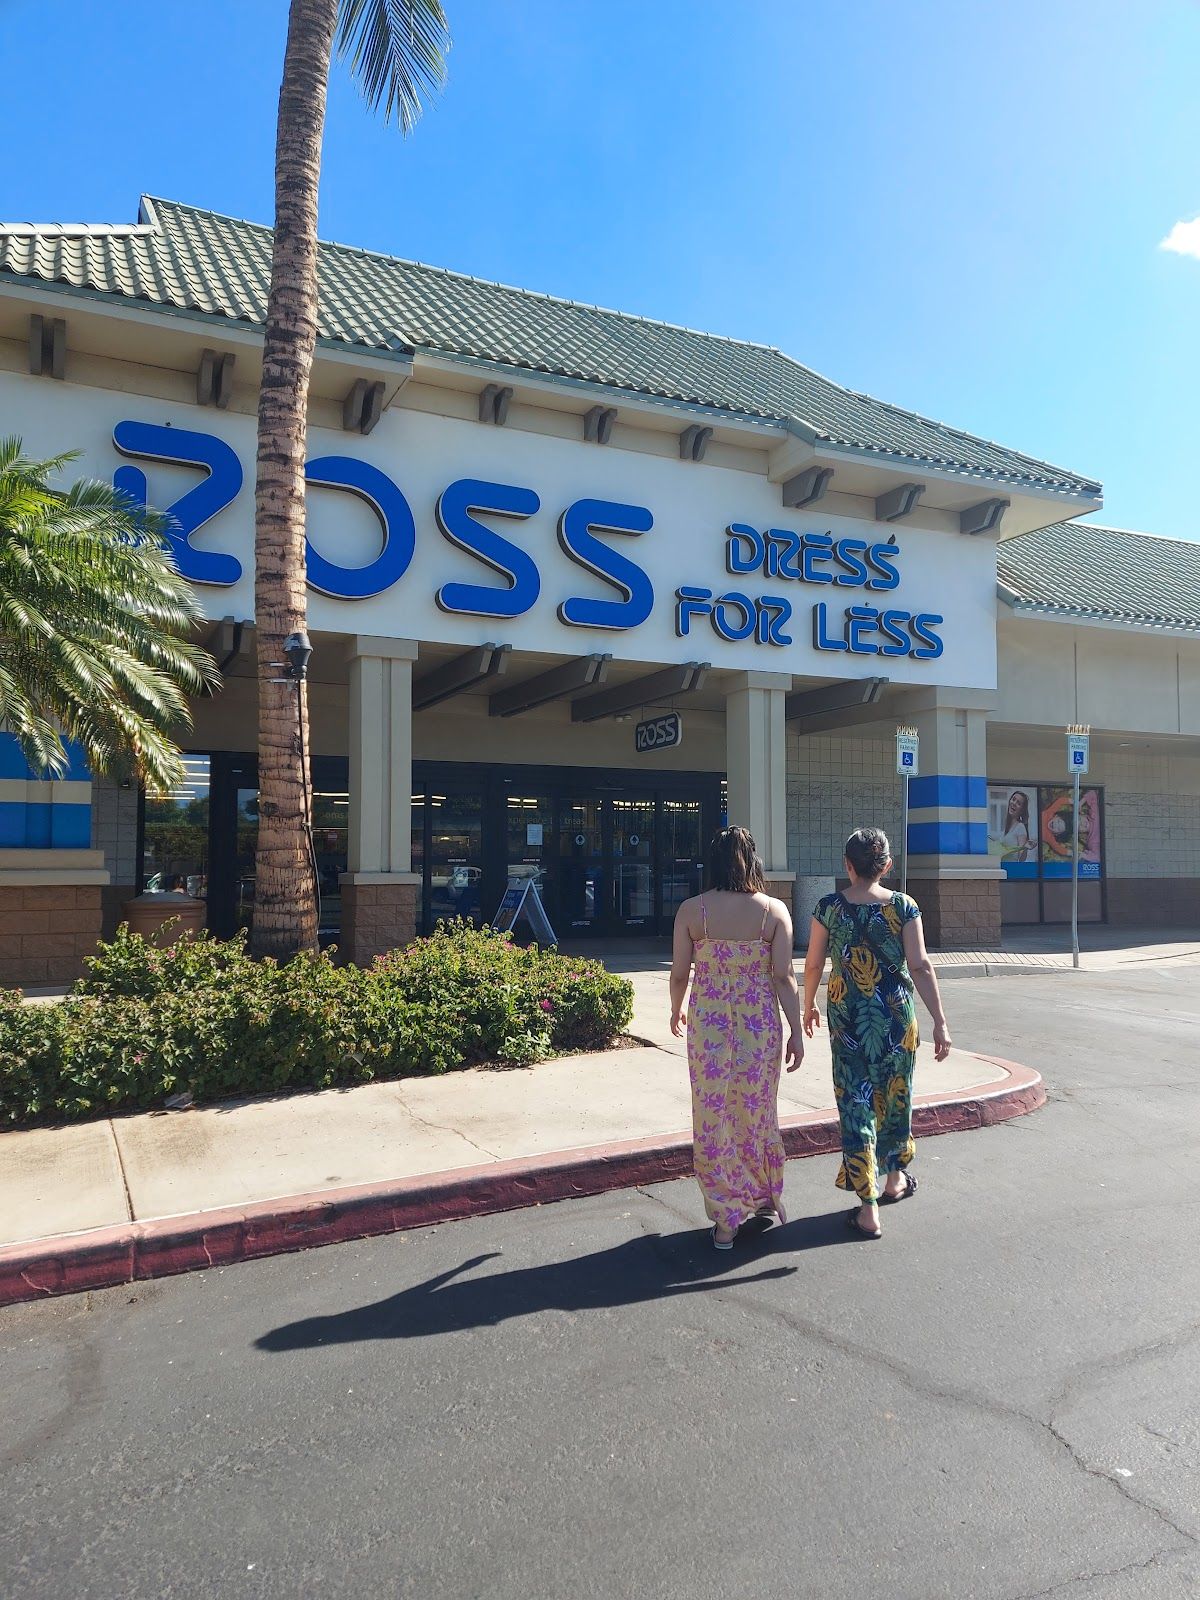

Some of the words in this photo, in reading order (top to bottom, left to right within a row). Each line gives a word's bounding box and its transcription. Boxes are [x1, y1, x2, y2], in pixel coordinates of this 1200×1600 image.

[113, 420, 654, 630] ROSS
[727, 523, 900, 591] DRESS
[676, 587, 792, 646] FOR
[813, 602, 944, 659] LESS
[637, 717, 676, 749] ROSS
[1082, 863, 1100, 871] ROSS
